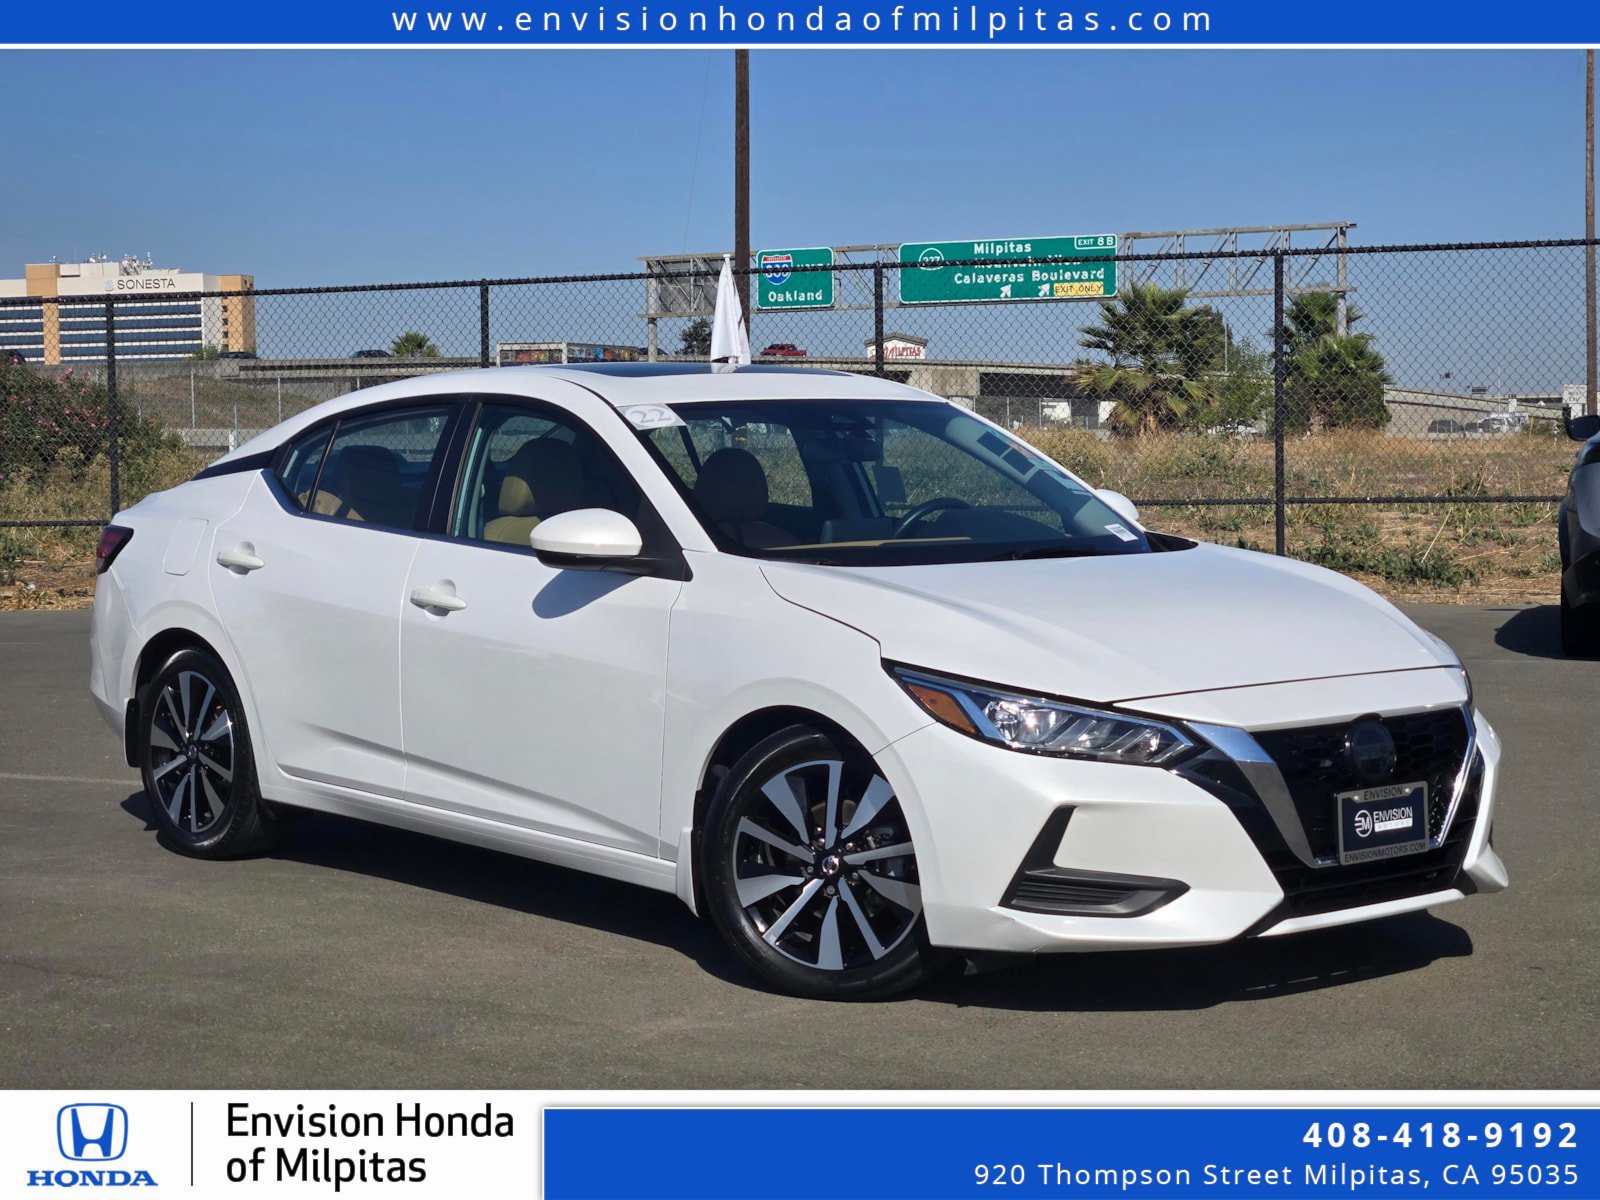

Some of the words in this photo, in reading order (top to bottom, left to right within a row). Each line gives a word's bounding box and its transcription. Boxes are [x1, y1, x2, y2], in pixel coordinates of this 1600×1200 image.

[973, 241, 1032, 256] Milpitas
[1077, 238, 1094, 247] EXIT
[954, 271, 1025, 285] Calaveras
[1031, 267, 1104, 282] Boulevard
[117, 278, 176, 290] SONESTA
[1078, 283, 1102, 293] ONLY
[768, 289, 823, 302] Oakland
[631, 408, 673, 424] 22
[1363, 786, 1403, 801] ENVISION
[1373, 806, 1413, 823] ENVISION
[1344, 841, 1427, 863] ENVISIONMOTORS.COM
